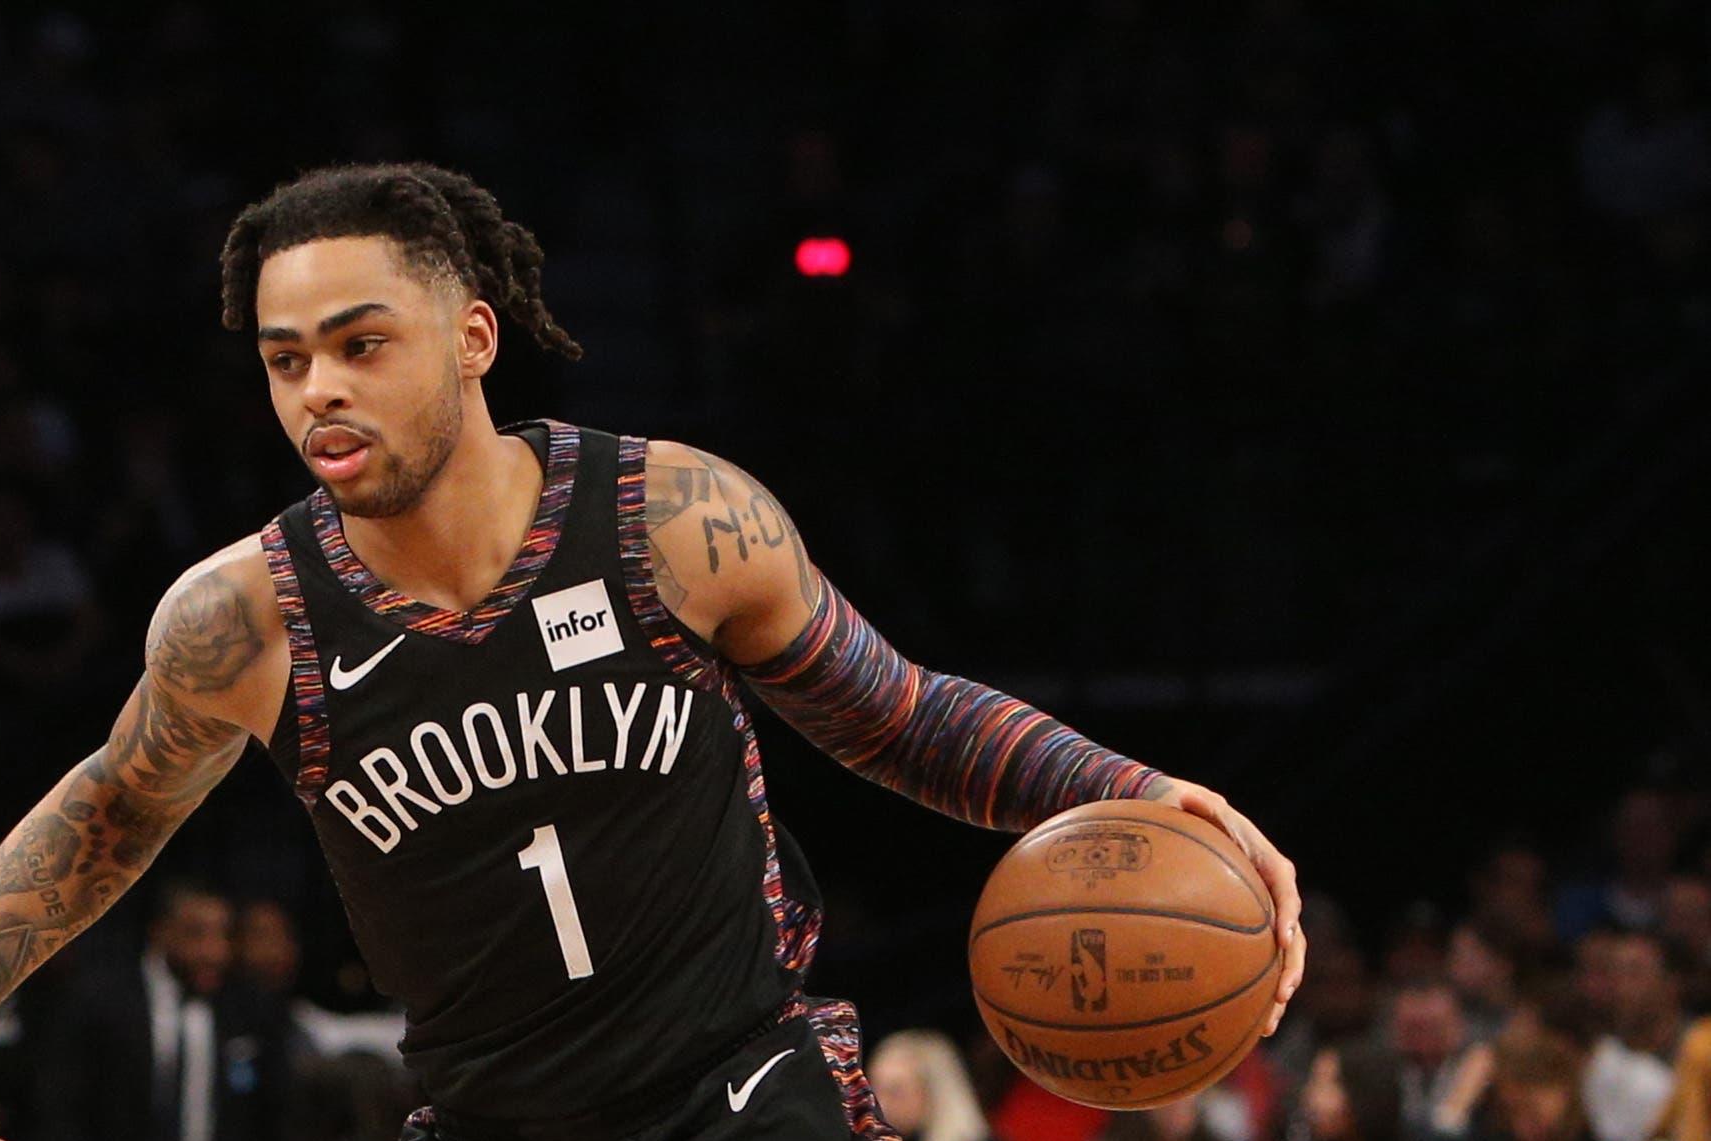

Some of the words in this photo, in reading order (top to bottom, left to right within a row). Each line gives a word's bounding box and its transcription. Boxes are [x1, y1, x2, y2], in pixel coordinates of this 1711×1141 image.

[545, 609, 607, 643] infor
[325, 681, 693, 854] BROOKLYN
[517, 824, 594, 980] 1
[999, 1021, 1214, 1083] SPALDING
